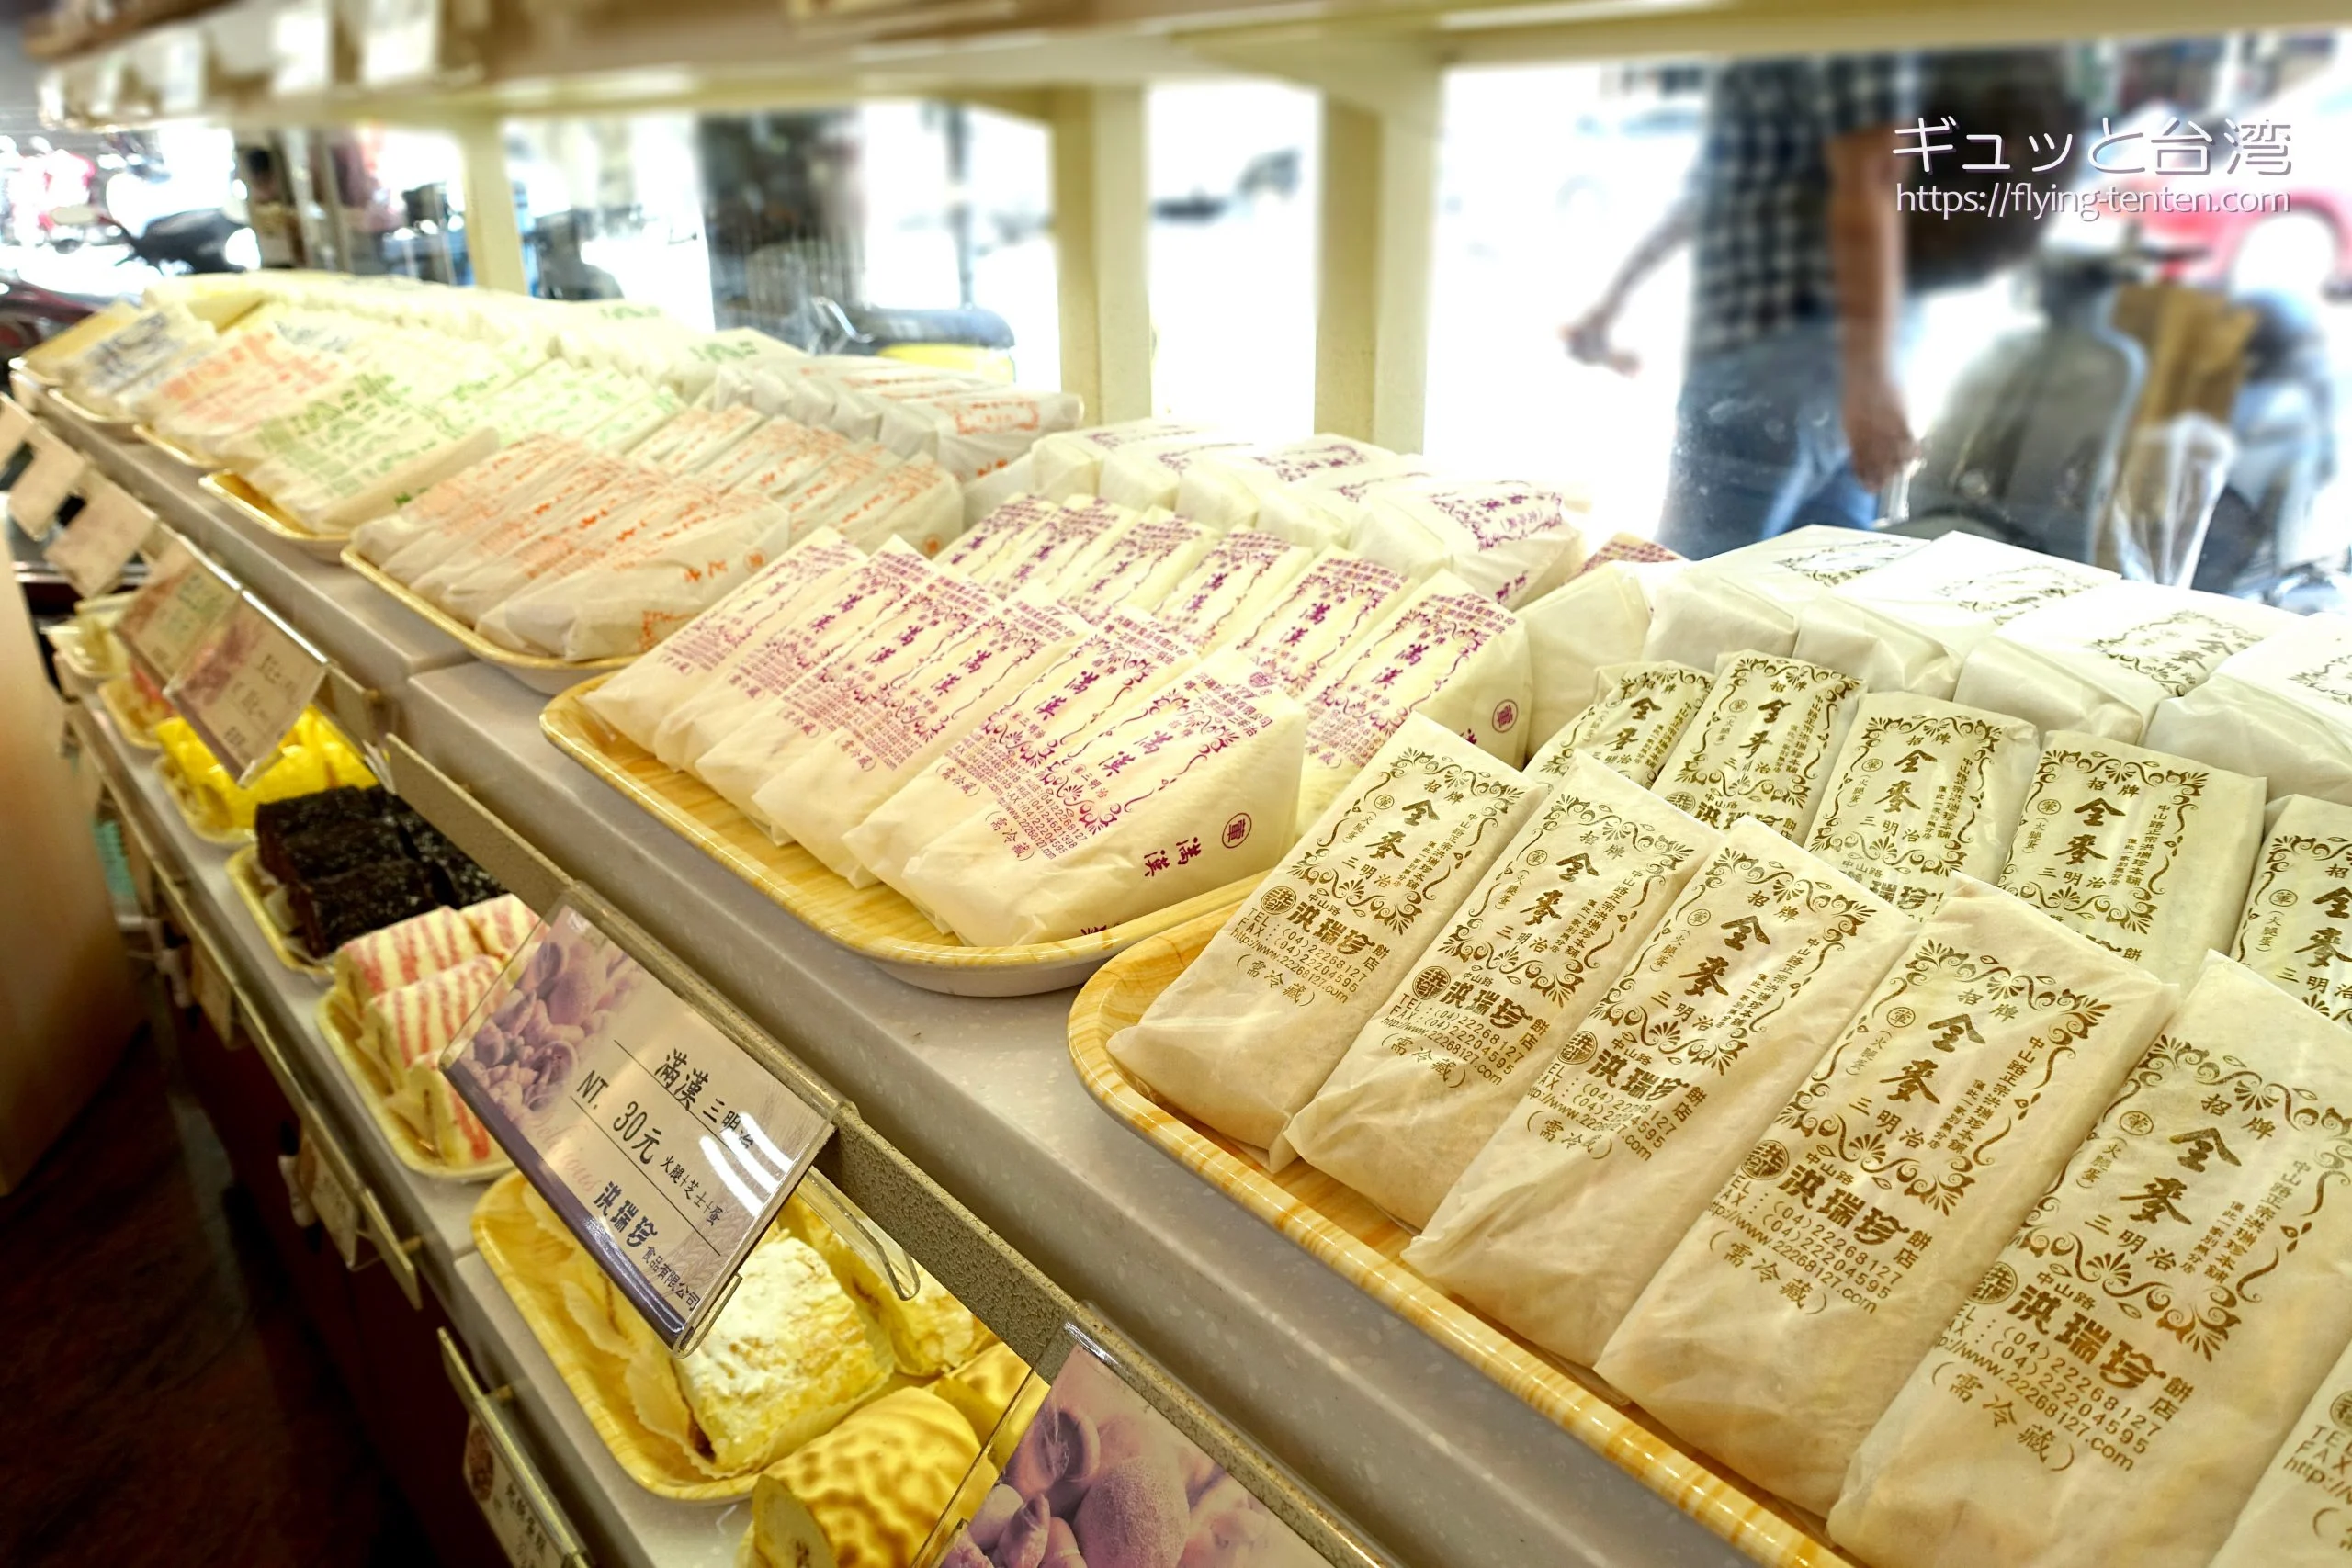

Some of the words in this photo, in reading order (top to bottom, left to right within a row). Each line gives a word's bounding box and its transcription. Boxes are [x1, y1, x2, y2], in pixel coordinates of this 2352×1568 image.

[1905, 732, 1951, 747] 招牌
[1423, 779, 1464, 805] 招牌
[1704, 793, 1738, 810] 中山路
[1874, 749, 1939, 814] 全麥
[2086, 777, 2141, 798] 招牌
[1365, 798, 1441, 860] 全麥
[1580, 829, 1626, 859] 招牌
[1859, 816, 1921, 843] 三明治
[2054, 797, 2127, 865] 全麥
[1143, 836, 1202, 877] 滿漢
[1341, 856, 1394, 888] 三明治
[1842, 860, 1883, 879] 中山路
[2037, 867, 2108, 889] 三明治
[1307, 893, 1341, 916] 中山路
[1519, 852, 1600, 926] 全麥
[1747, 889, 1797, 922] 招牌
[1286, 901, 1376, 956] 洪瑞珍
[1496, 925, 1549, 954] 三明治
[1678, 915, 1770, 998] 全麥
[1462, 971, 1494, 987] 中山路
[2276, 967, 2352, 999] 三明治
[1439, 981, 1533, 1030] 洪瑞珍
[1651, 990, 1713, 1032] 三明治
[1956, 987, 2019, 1023] 招牌
[1611, 1037, 1654, 1066] 中山路
[1879, 1013, 1985, 1105] 全麥
[654, 1046, 708, 1111] 滿漢
[1585, 1048, 1690, 1101] 洪瑞珍
[612, 1100, 664, 1165] 30元
[1848, 1096, 1928, 1150] 三明治
[2199, 1093, 2277, 1140] 招牌
[1804, 1152, 1854, 1187] 中山路
[2117, 1125, 2242, 1226] 全麥
[1776, 1163, 1910, 1247] 洪瑞珍
[592, 1179, 658, 1248] 洪瑞珍
[641, 1245, 701, 1312] 食品有限公司
[2084, 1213, 2178, 1273] 三明治
[1709, 1229, 1827, 1314] (需冷藏)
[2036, 1271, 2097, 1311] 中山路
[2007, 1284, 2167, 1390] 洪瑞珍
[1931, 1360, 2075, 1472] (需冷藏)
